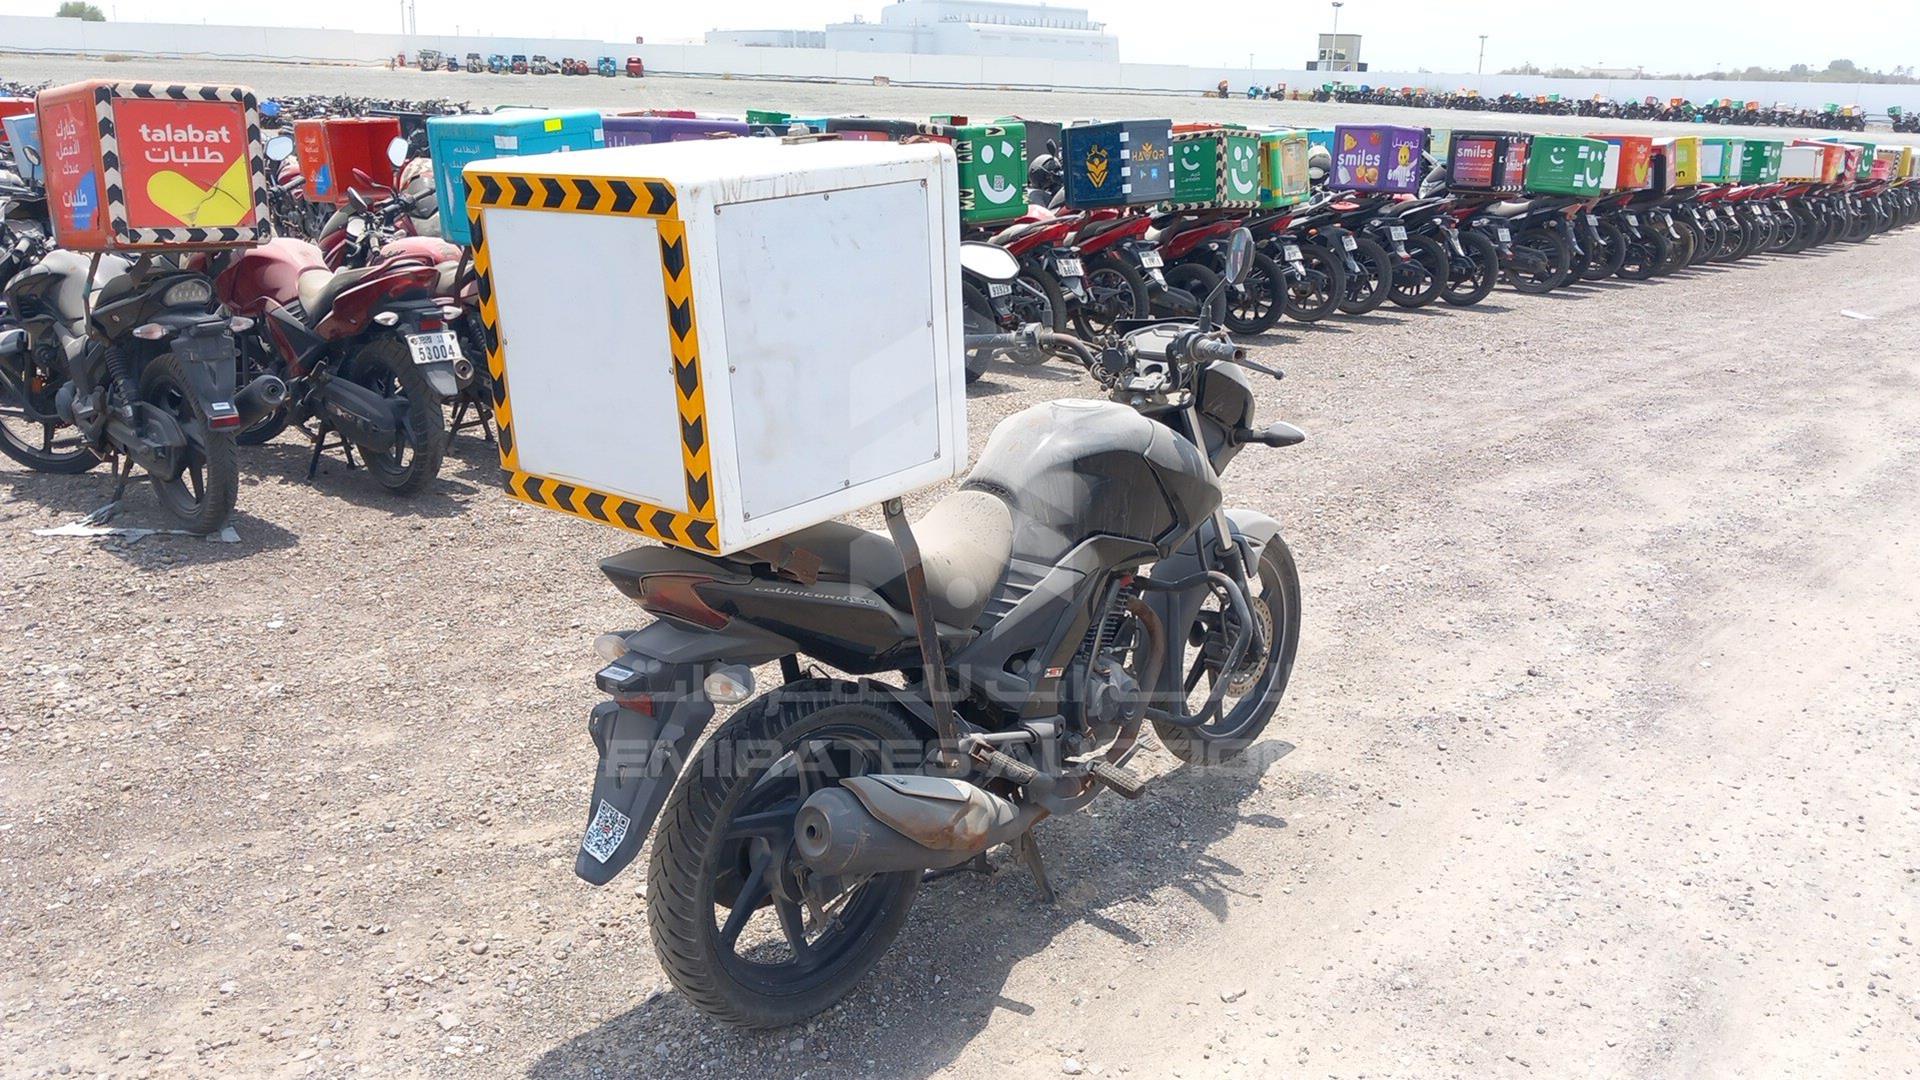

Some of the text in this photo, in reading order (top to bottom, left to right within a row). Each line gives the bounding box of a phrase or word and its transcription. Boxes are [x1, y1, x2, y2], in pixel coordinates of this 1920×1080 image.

[138, 123, 231, 143] talabat
[144, 146, 225, 167] طلبات
[1337, 149, 1381, 167] smiles
[1456, 145, 1494, 158] smiles
[62, 189, 88, 210] طلبات
[418, 344, 456, 362] 53004
